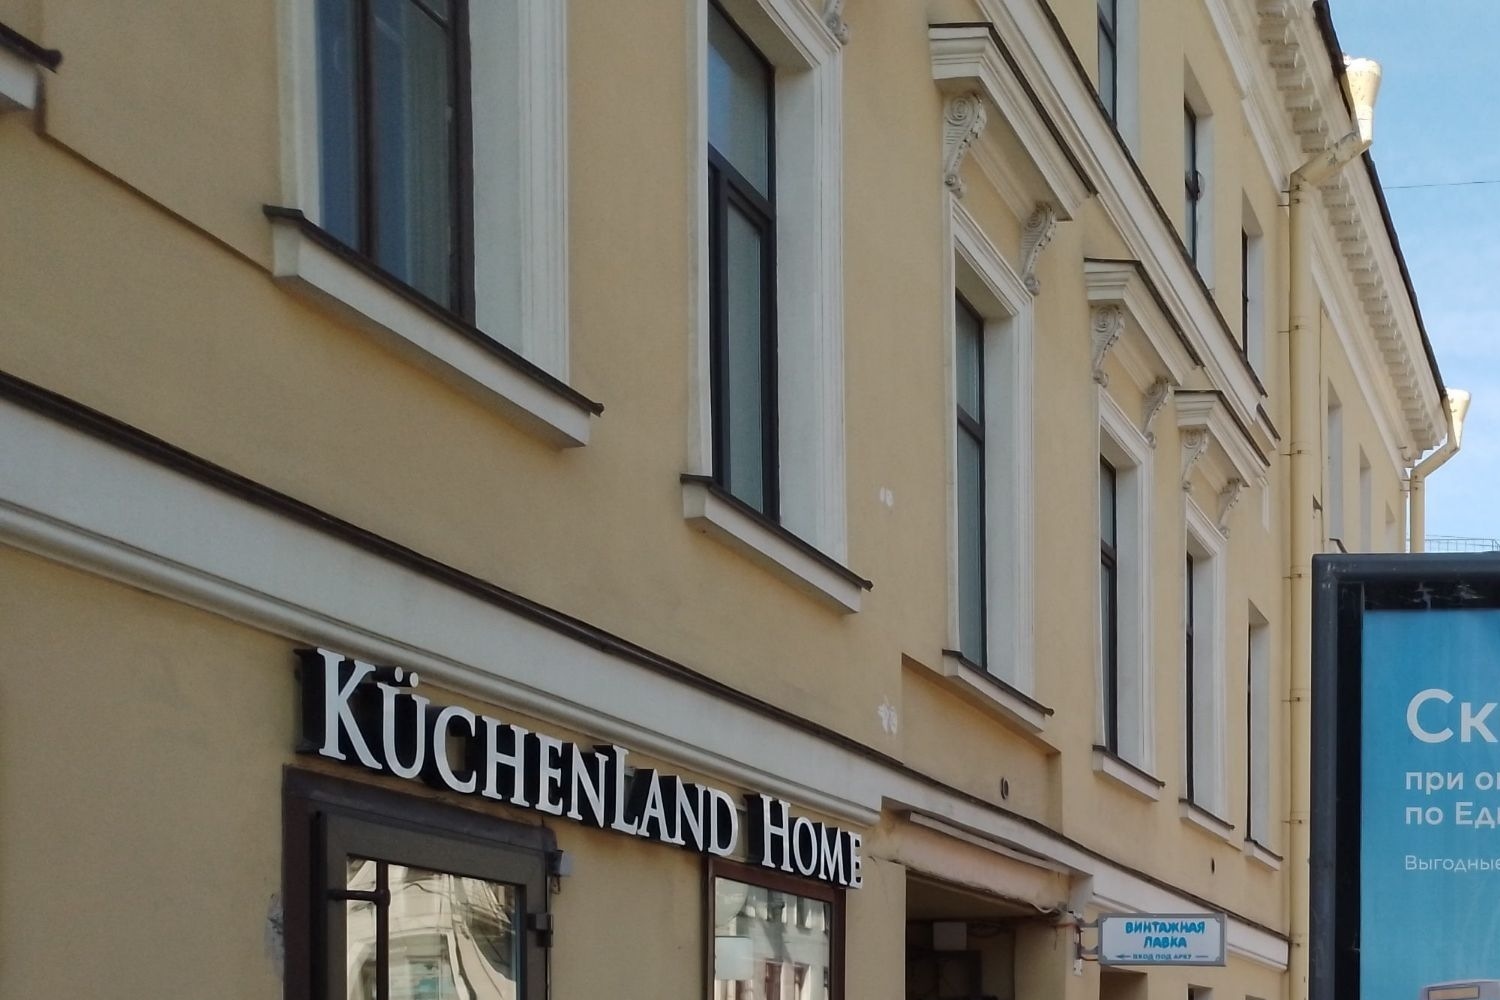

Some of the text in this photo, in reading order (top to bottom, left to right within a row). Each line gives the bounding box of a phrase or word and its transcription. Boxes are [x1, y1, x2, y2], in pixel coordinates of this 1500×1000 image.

[1405, 771, 1469, 794] при
[1405, 805, 1443, 825] по
[759, 793, 864, 889] HOME
[1125, 920, 1205, 934] ВИНТАЖНАЯ
[1143, 935, 1188, 949] ЛАВКА
